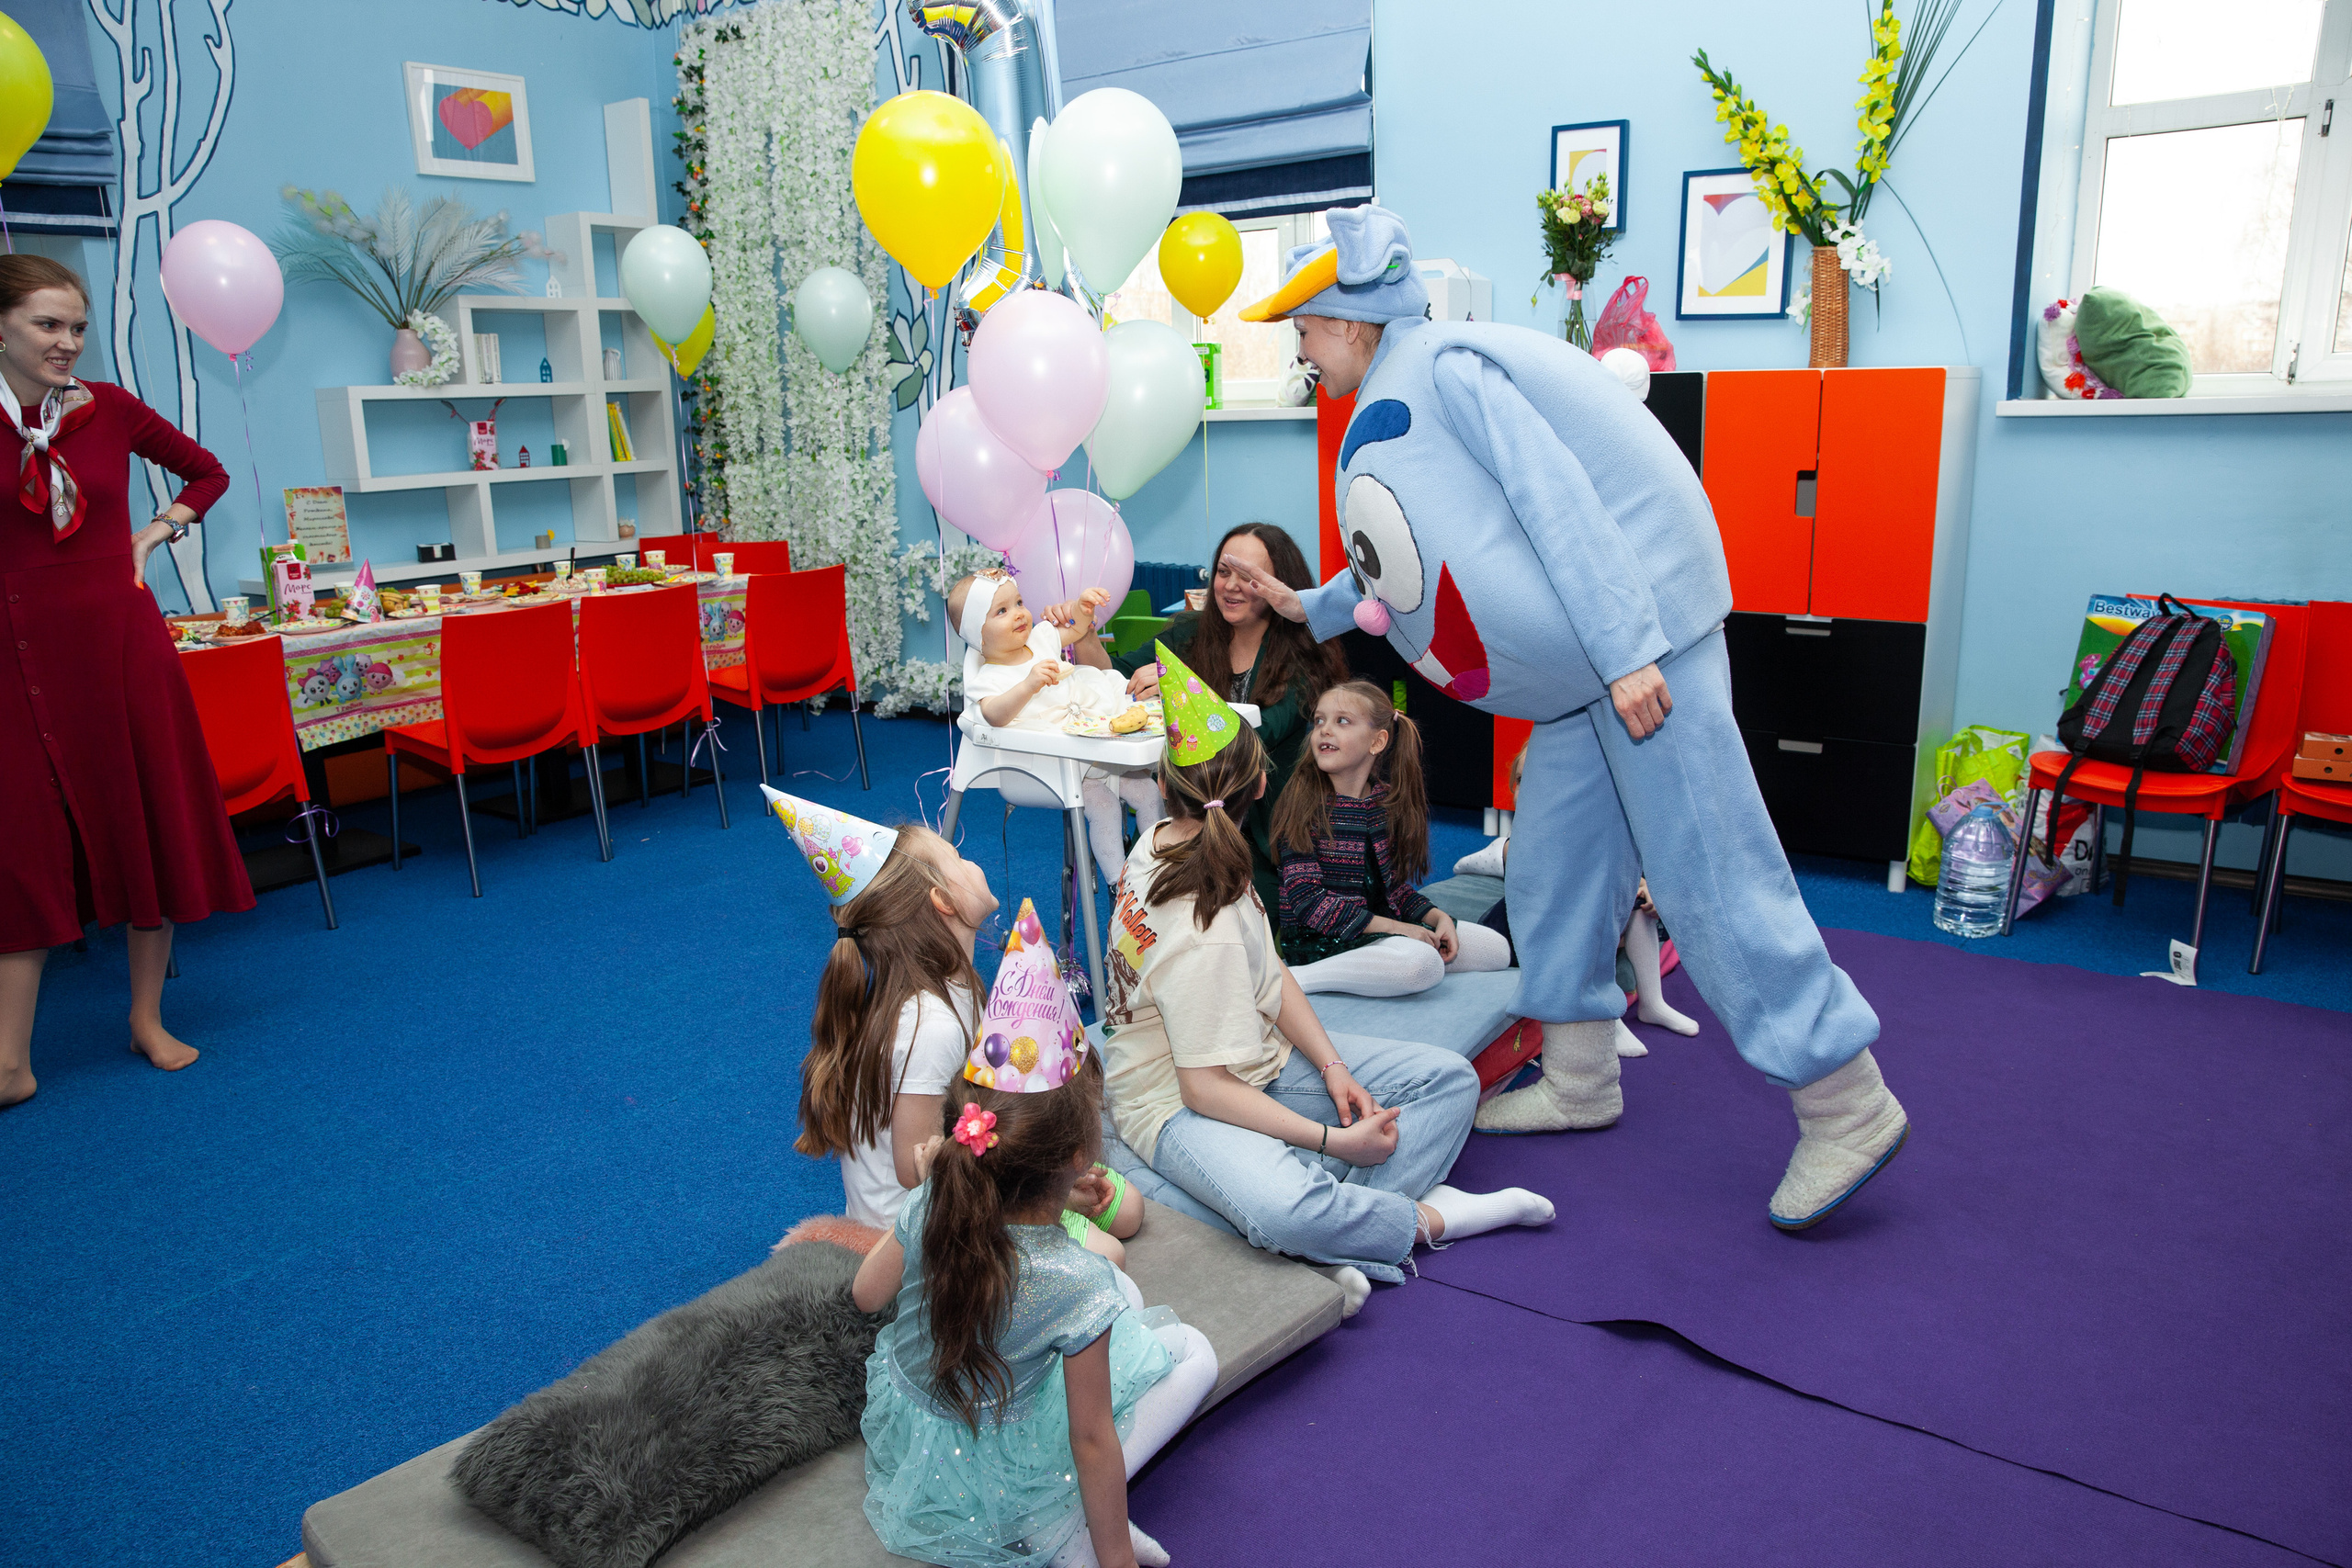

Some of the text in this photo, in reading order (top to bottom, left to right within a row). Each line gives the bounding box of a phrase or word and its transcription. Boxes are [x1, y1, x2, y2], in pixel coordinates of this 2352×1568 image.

[284, 583, 311, 595] Морс
[1118, 889, 1158, 956] Valley
[1000, 962, 1056, 1001] С Днём
